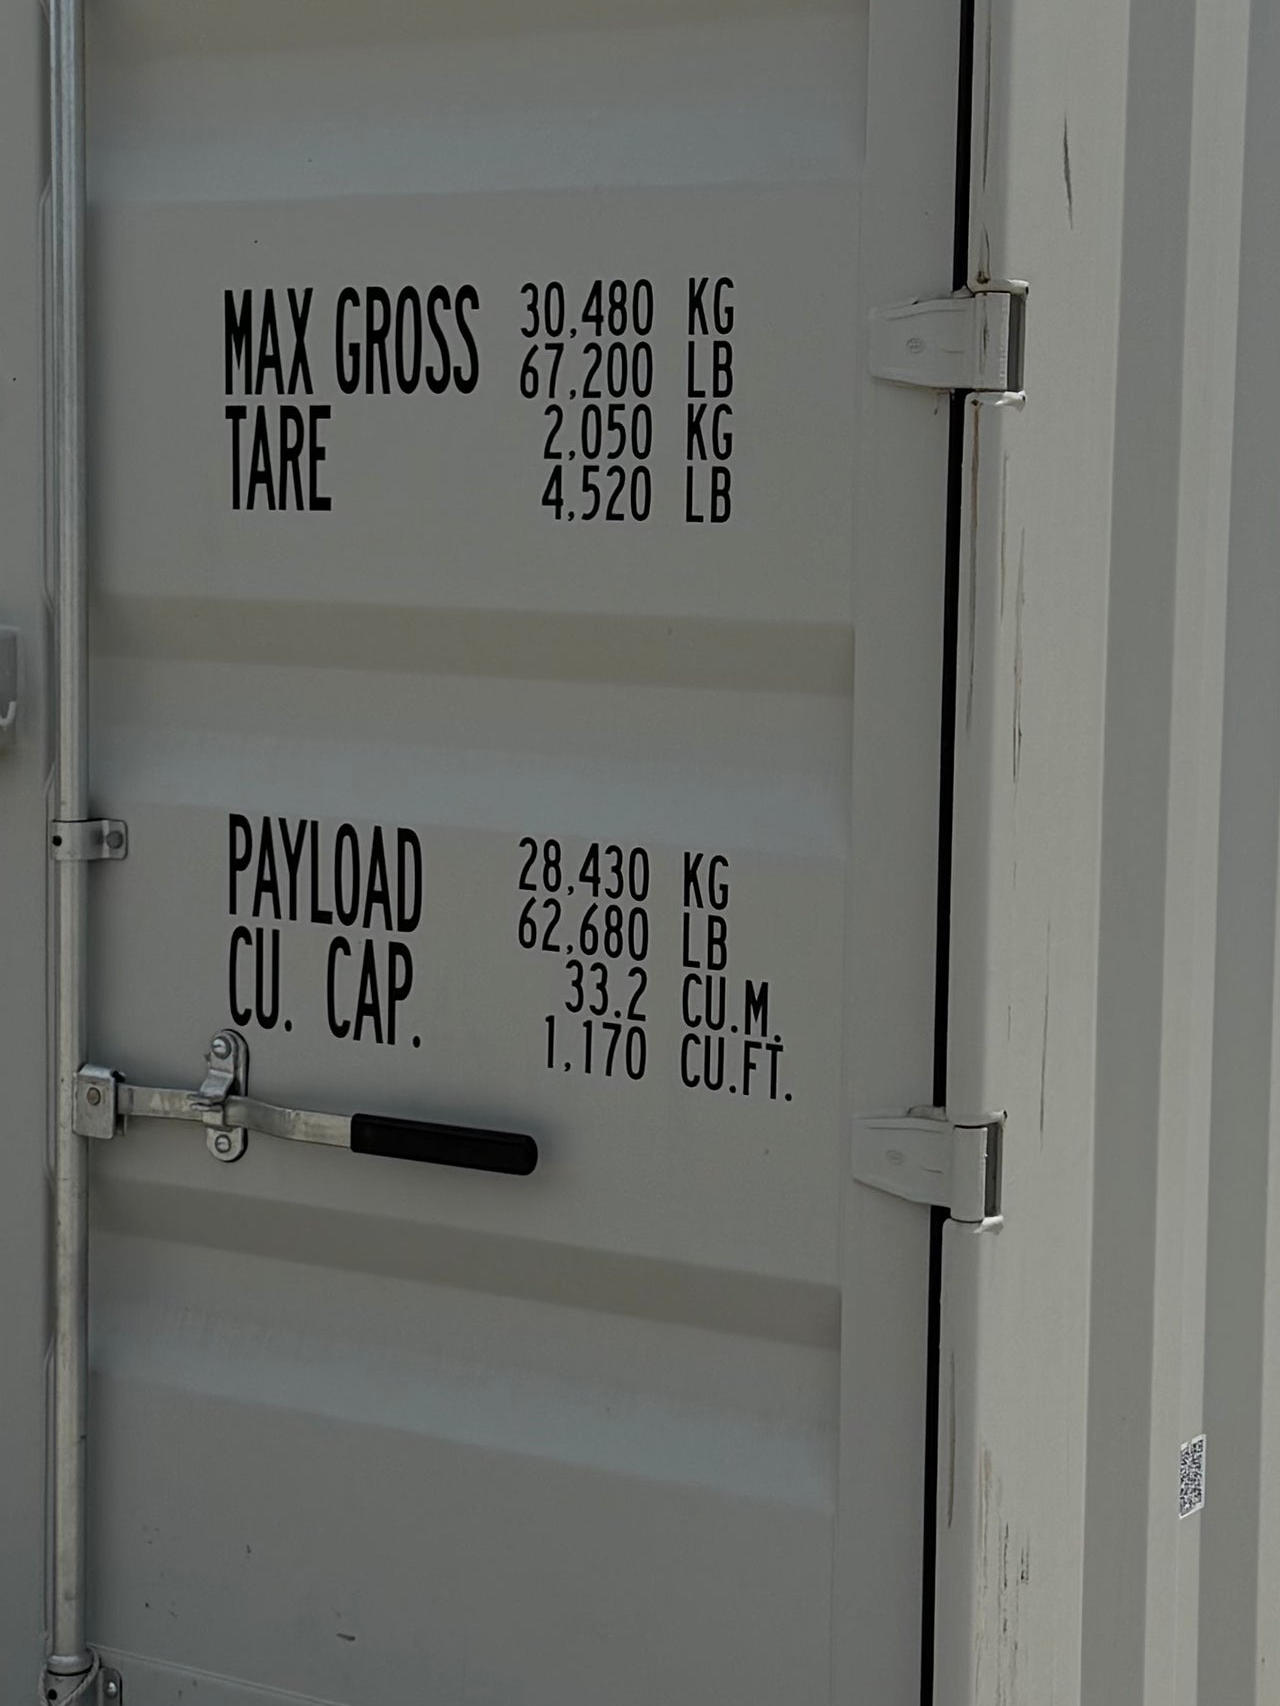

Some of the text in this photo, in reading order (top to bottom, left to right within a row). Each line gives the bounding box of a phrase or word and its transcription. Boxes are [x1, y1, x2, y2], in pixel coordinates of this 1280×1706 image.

[224, 276, 735, 396] MAX GROSS 30,480 KG
[519, 340, 734, 400] 67,200 LB
[224, 402, 733, 512] TARE 2,050 KG
[541, 464, 732, 524] 4,520 LB
[228, 812, 729, 933] PAYLOAD 28,430 KG
[518, 896, 728, 972] 62,680 LB
[228, 925, 421, 1049] CU. CAP.
[564, 959, 782, 1043] 33.2 CU.M.
[544, 1015, 793, 1102] 1,170 CU.FT.
